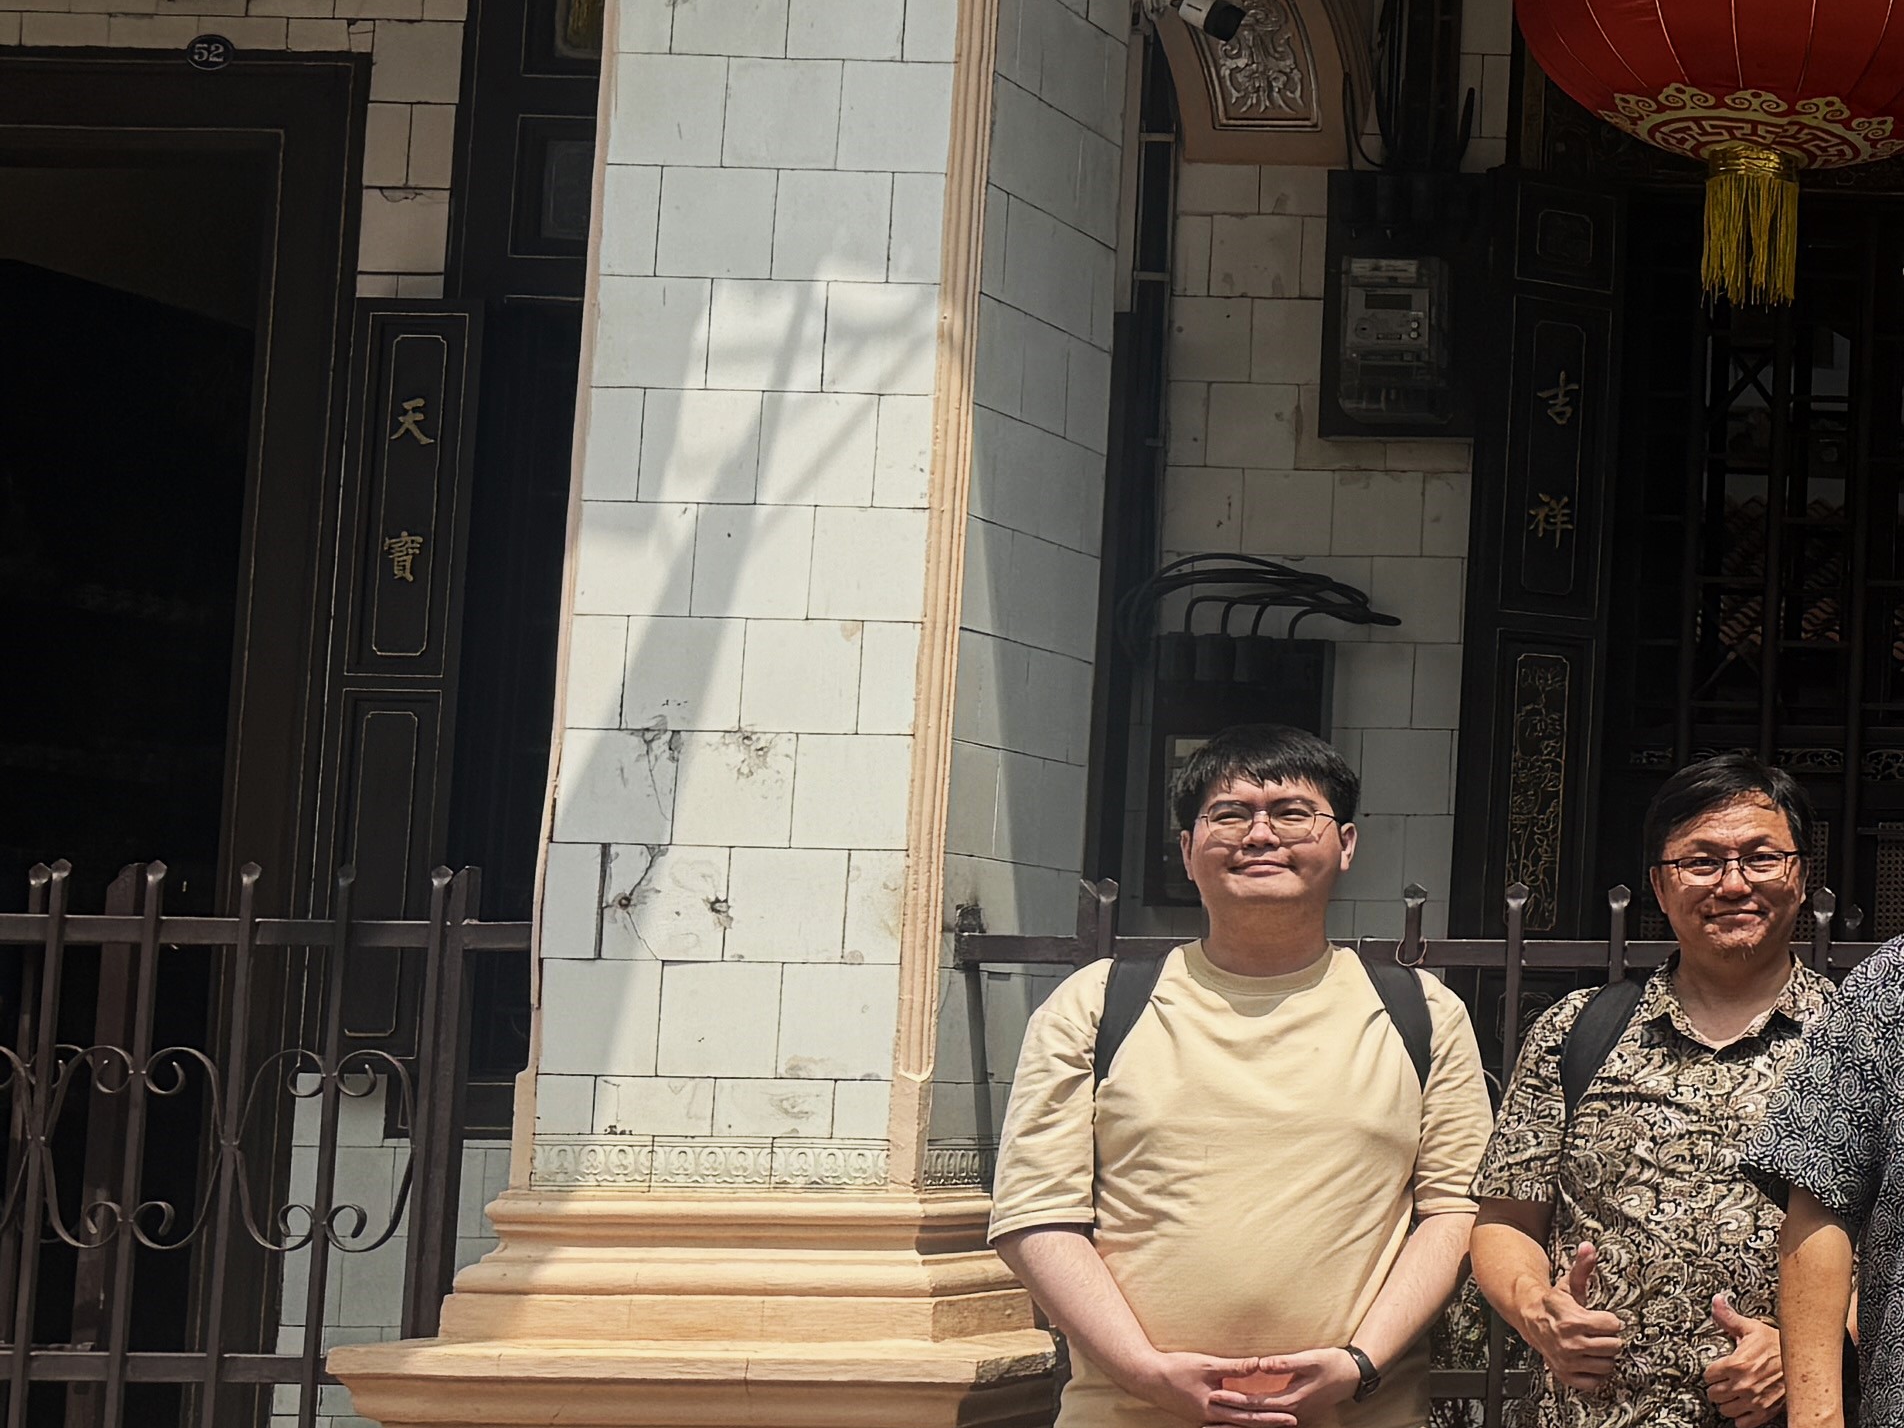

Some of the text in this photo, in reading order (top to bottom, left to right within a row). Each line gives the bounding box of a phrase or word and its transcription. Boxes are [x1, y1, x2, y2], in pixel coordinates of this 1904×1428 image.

[193, 42, 225, 63] 52
[384, 397, 435, 583] 天寶
[1527, 369, 1581, 549] 吉祥
